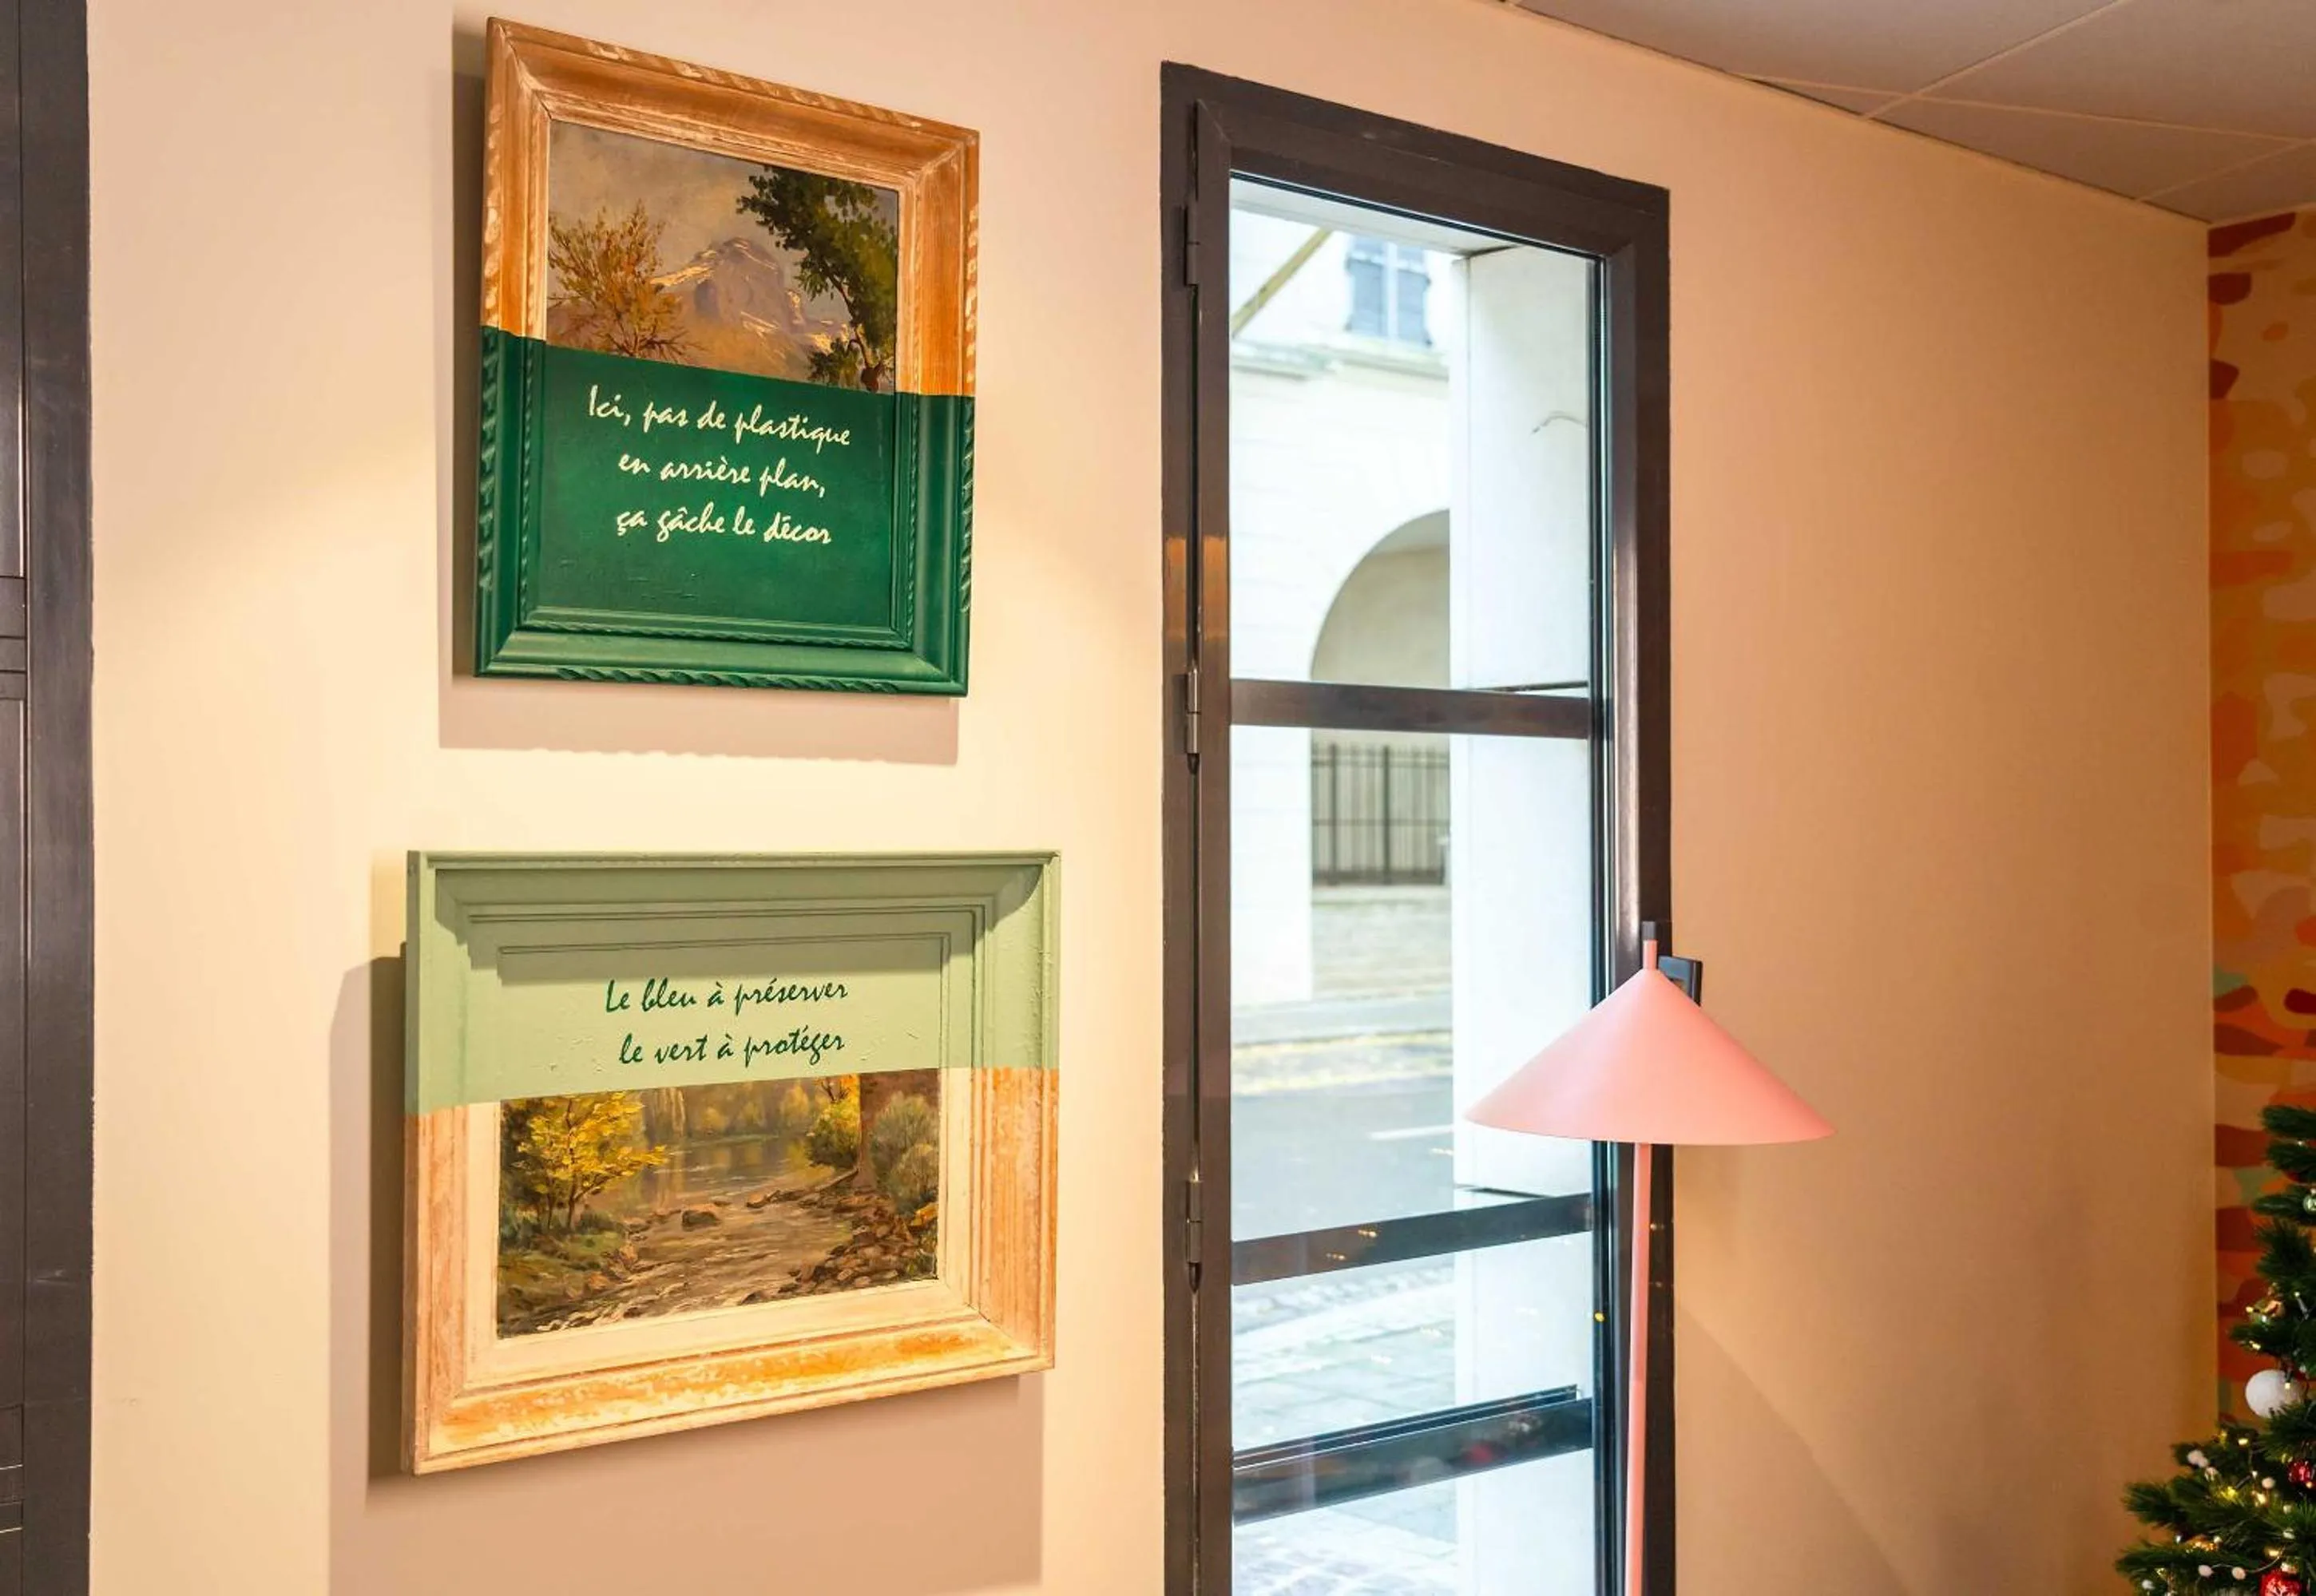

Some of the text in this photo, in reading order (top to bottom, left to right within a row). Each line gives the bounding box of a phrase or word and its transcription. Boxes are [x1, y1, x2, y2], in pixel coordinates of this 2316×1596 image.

[589, 384, 851, 454] Ici, pas de plastique
[618, 453, 825, 498] en arrière plan,
[616, 501, 832, 545] ça gâche le décor
[605, 976, 848, 1016] Le bleu à préserver
[619, 1024, 846, 1068] le vert à protéger
